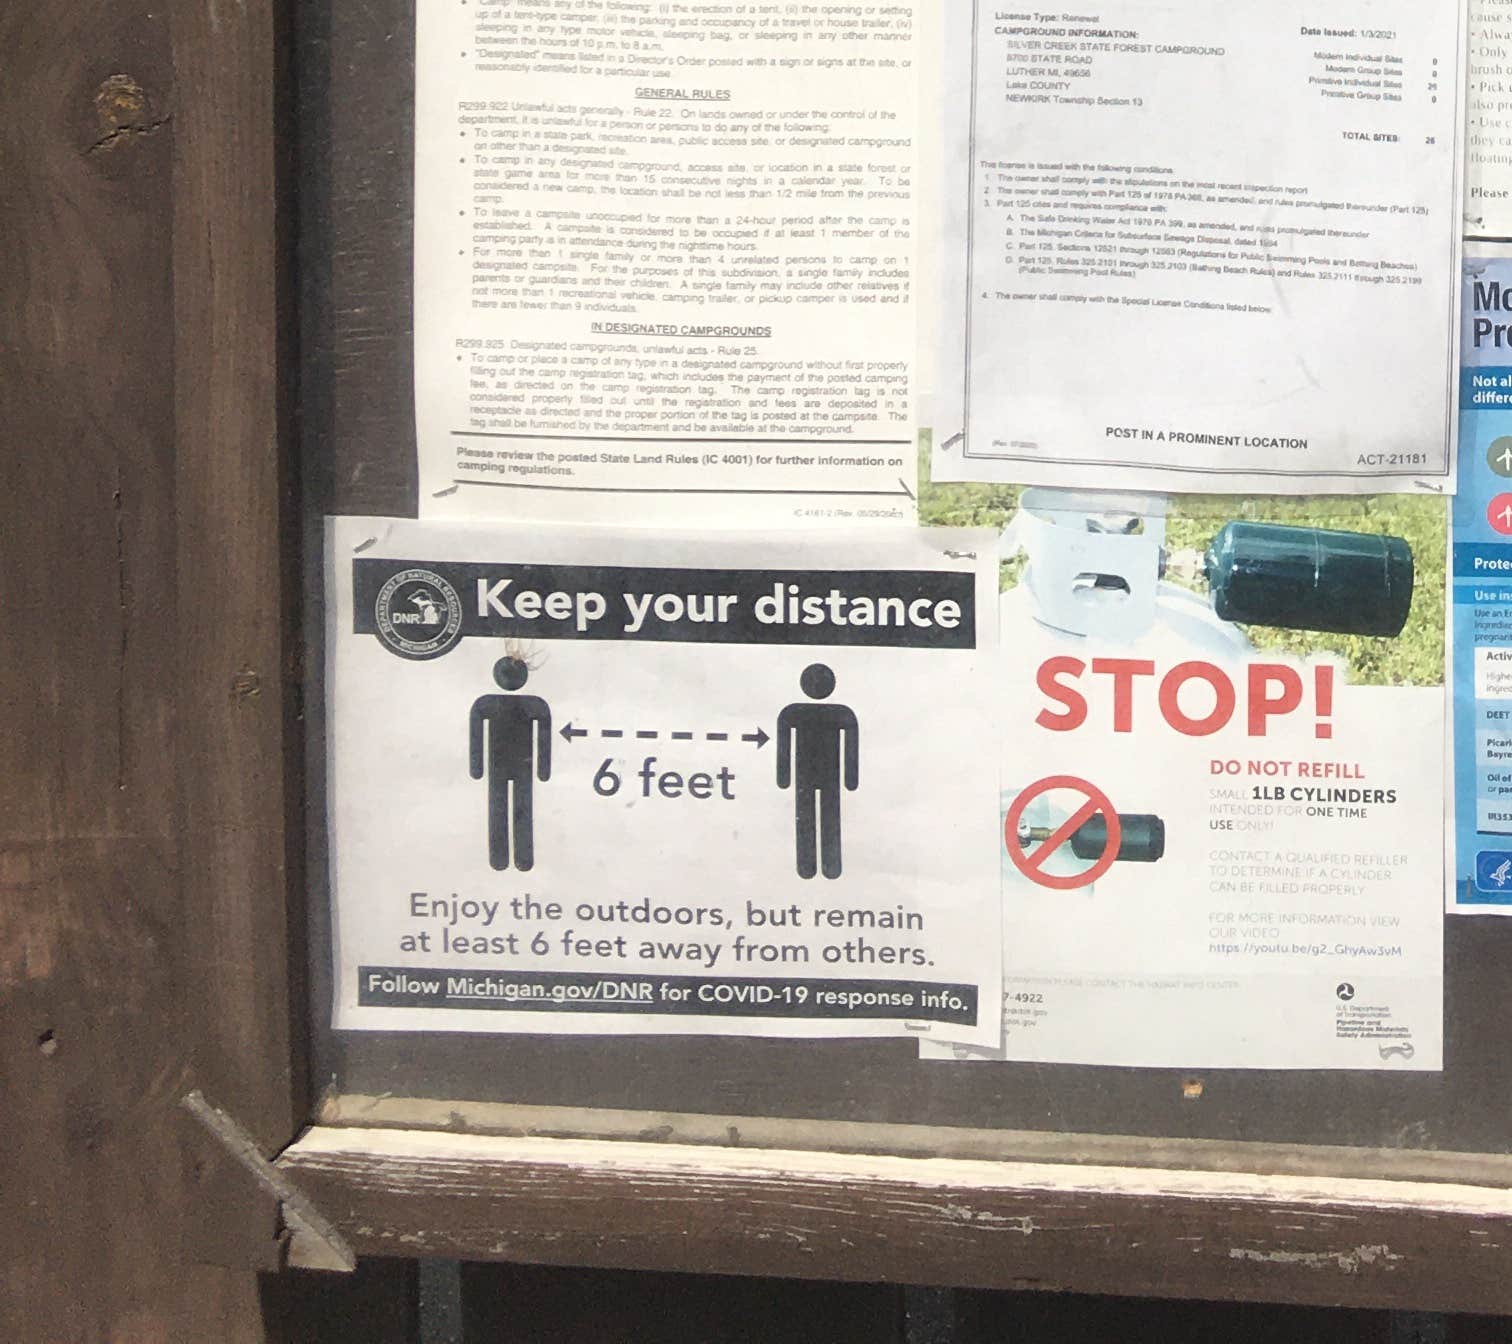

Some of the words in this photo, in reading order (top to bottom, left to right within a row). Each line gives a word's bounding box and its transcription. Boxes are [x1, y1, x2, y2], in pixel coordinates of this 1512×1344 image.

[1105, 426, 1139, 438] POST
[1141, 429, 1153, 440] IN
[1155, 430, 1165, 441] A
[1168, 431, 1241, 446] PROMINENT
[1243, 436, 1308, 449] LOCATION
[1356, 452, 1426, 465] ACT-21181
[477, 578, 607, 630] Keep
[622, 593, 738, 632] your
[754, 583, 961, 627] distance
[393, 613, 420, 625] DNR
[1034, 656, 1334, 737] STOP!
[592, 757, 621, 796] 6
[637, 757, 735, 799] feet
[1210, 759, 1242, 775] DO
[1247, 759, 1293, 776] NOT
[1297, 761, 1365, 779] REFILL
[1252, 785, 1286, 801] 1LB
[1290, 787, 1398, 803] CYLINDERS
[1305, 806, 1334, 817] ONE
[1336, 806, 1367, 818] TIME
[1209, 819, 1233, 830] USE
[409, 892, 499, 926] Enjoy
[509, 893, 563, 920] the
[575, 898, 732, 929] outdoors,
[745, 900, 802, 926] but
[813, 905, 923, 930] remain
[399, 931, 431, 952] at
[442, 927, 519, 955] least
[530, 930, 549, 955] 6
[560, 929, 627, 957] feet
[638, 941, 722, 967] away
[731, 935, 809, 962] from
[821, 937, 934, 966] others.
[368, 974, 440, 993] Follow
[445, 977, 654, 1003] Michigan.gov/DNR
[659, 981, 692, 1001] for
[697, 984, 809, 1003] COVID-19
[815, 991, 914, 1009] response
[921, 989, 968, 1010] info.
